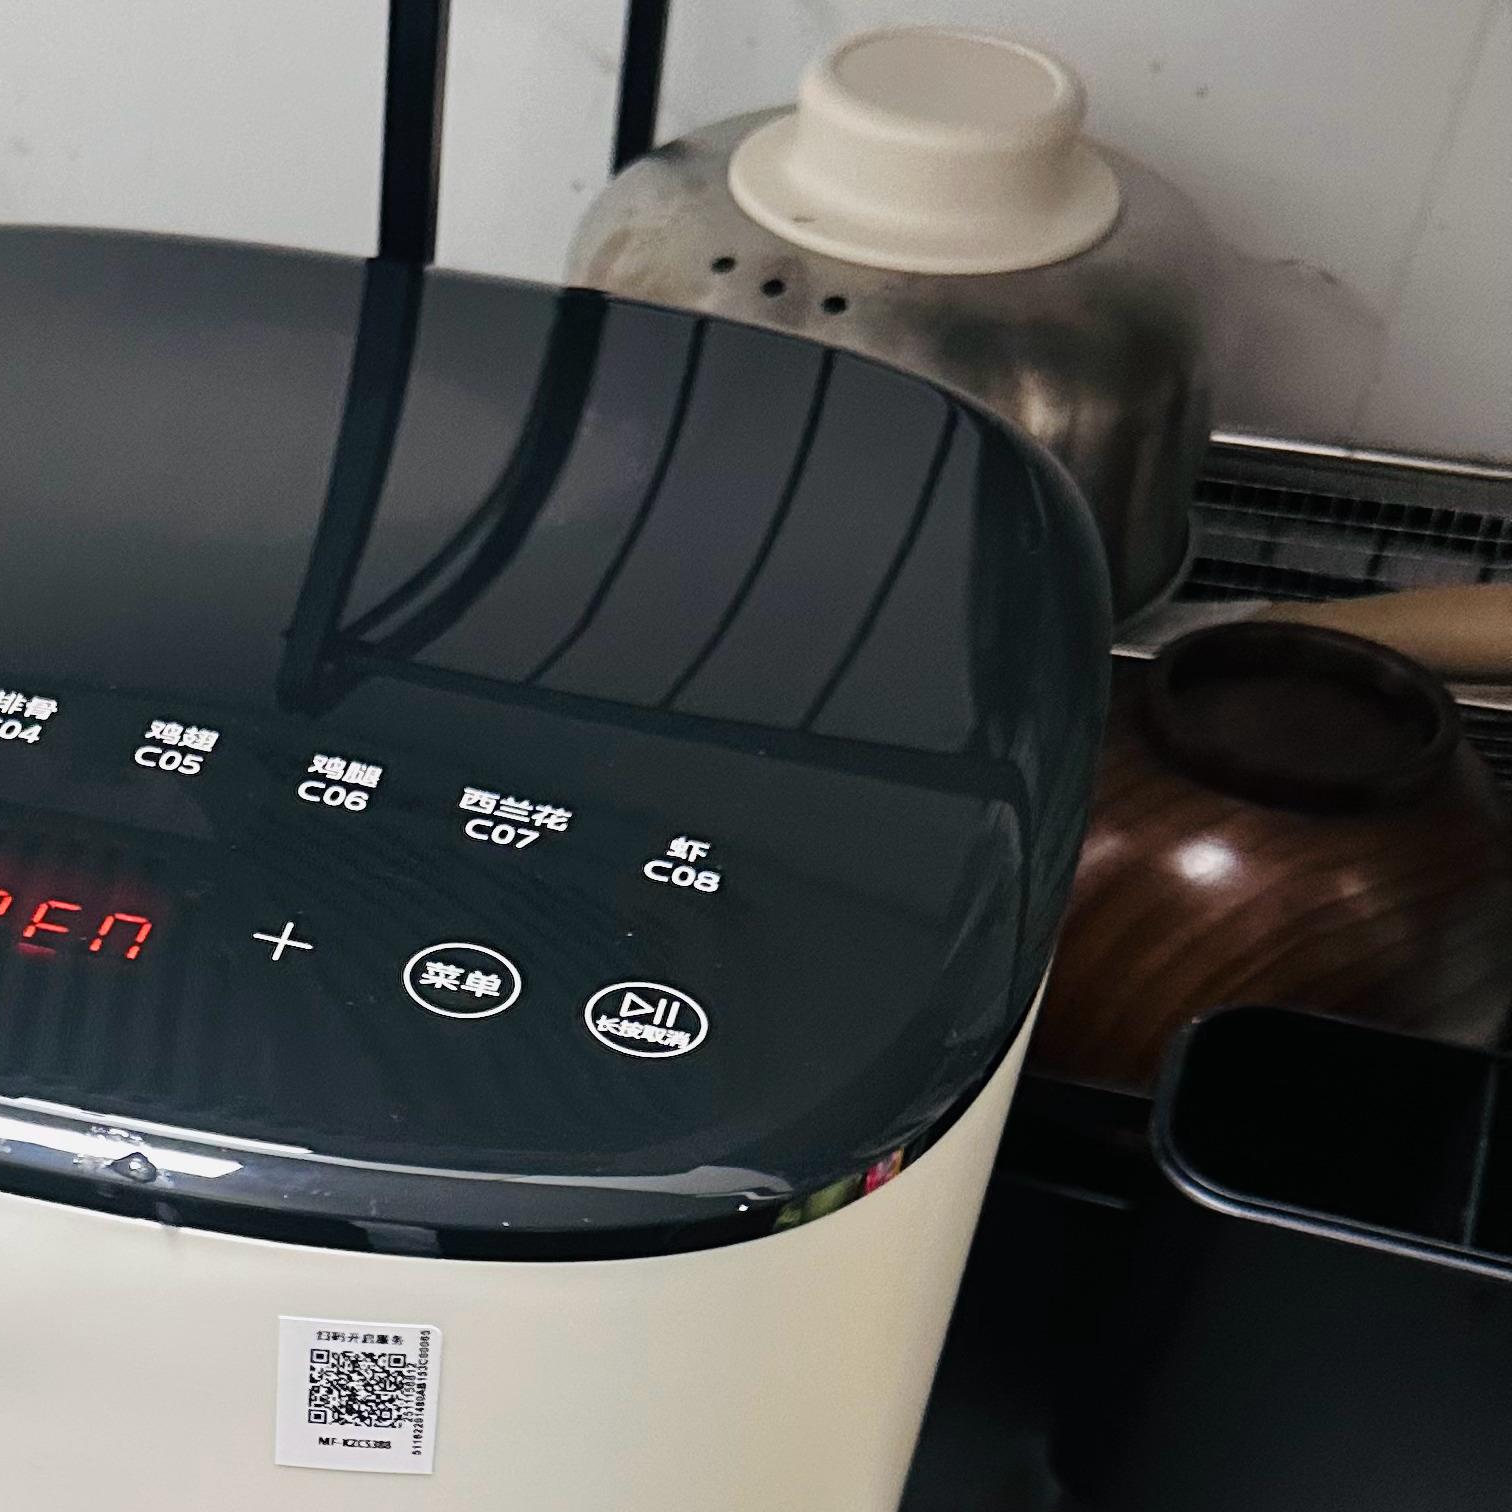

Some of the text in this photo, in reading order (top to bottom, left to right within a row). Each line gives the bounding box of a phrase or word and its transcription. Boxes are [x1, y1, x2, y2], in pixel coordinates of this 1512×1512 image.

[144, 719, 220, 752] 鸡翅
[134, 744, 204, 776] C05
[307, 753, 383, 788] 鸡腿
[297, 779, 369, 812] C06
[458, 785, 573, 832] 西兰花
[464, 817, 540, 849] C07
[665, 836, 712, 863] 虾
[642, 859, 721, 894] C08
[418, 961, 503, 998] 菜单
[595, 1014, 691, 1050] 长按取消
